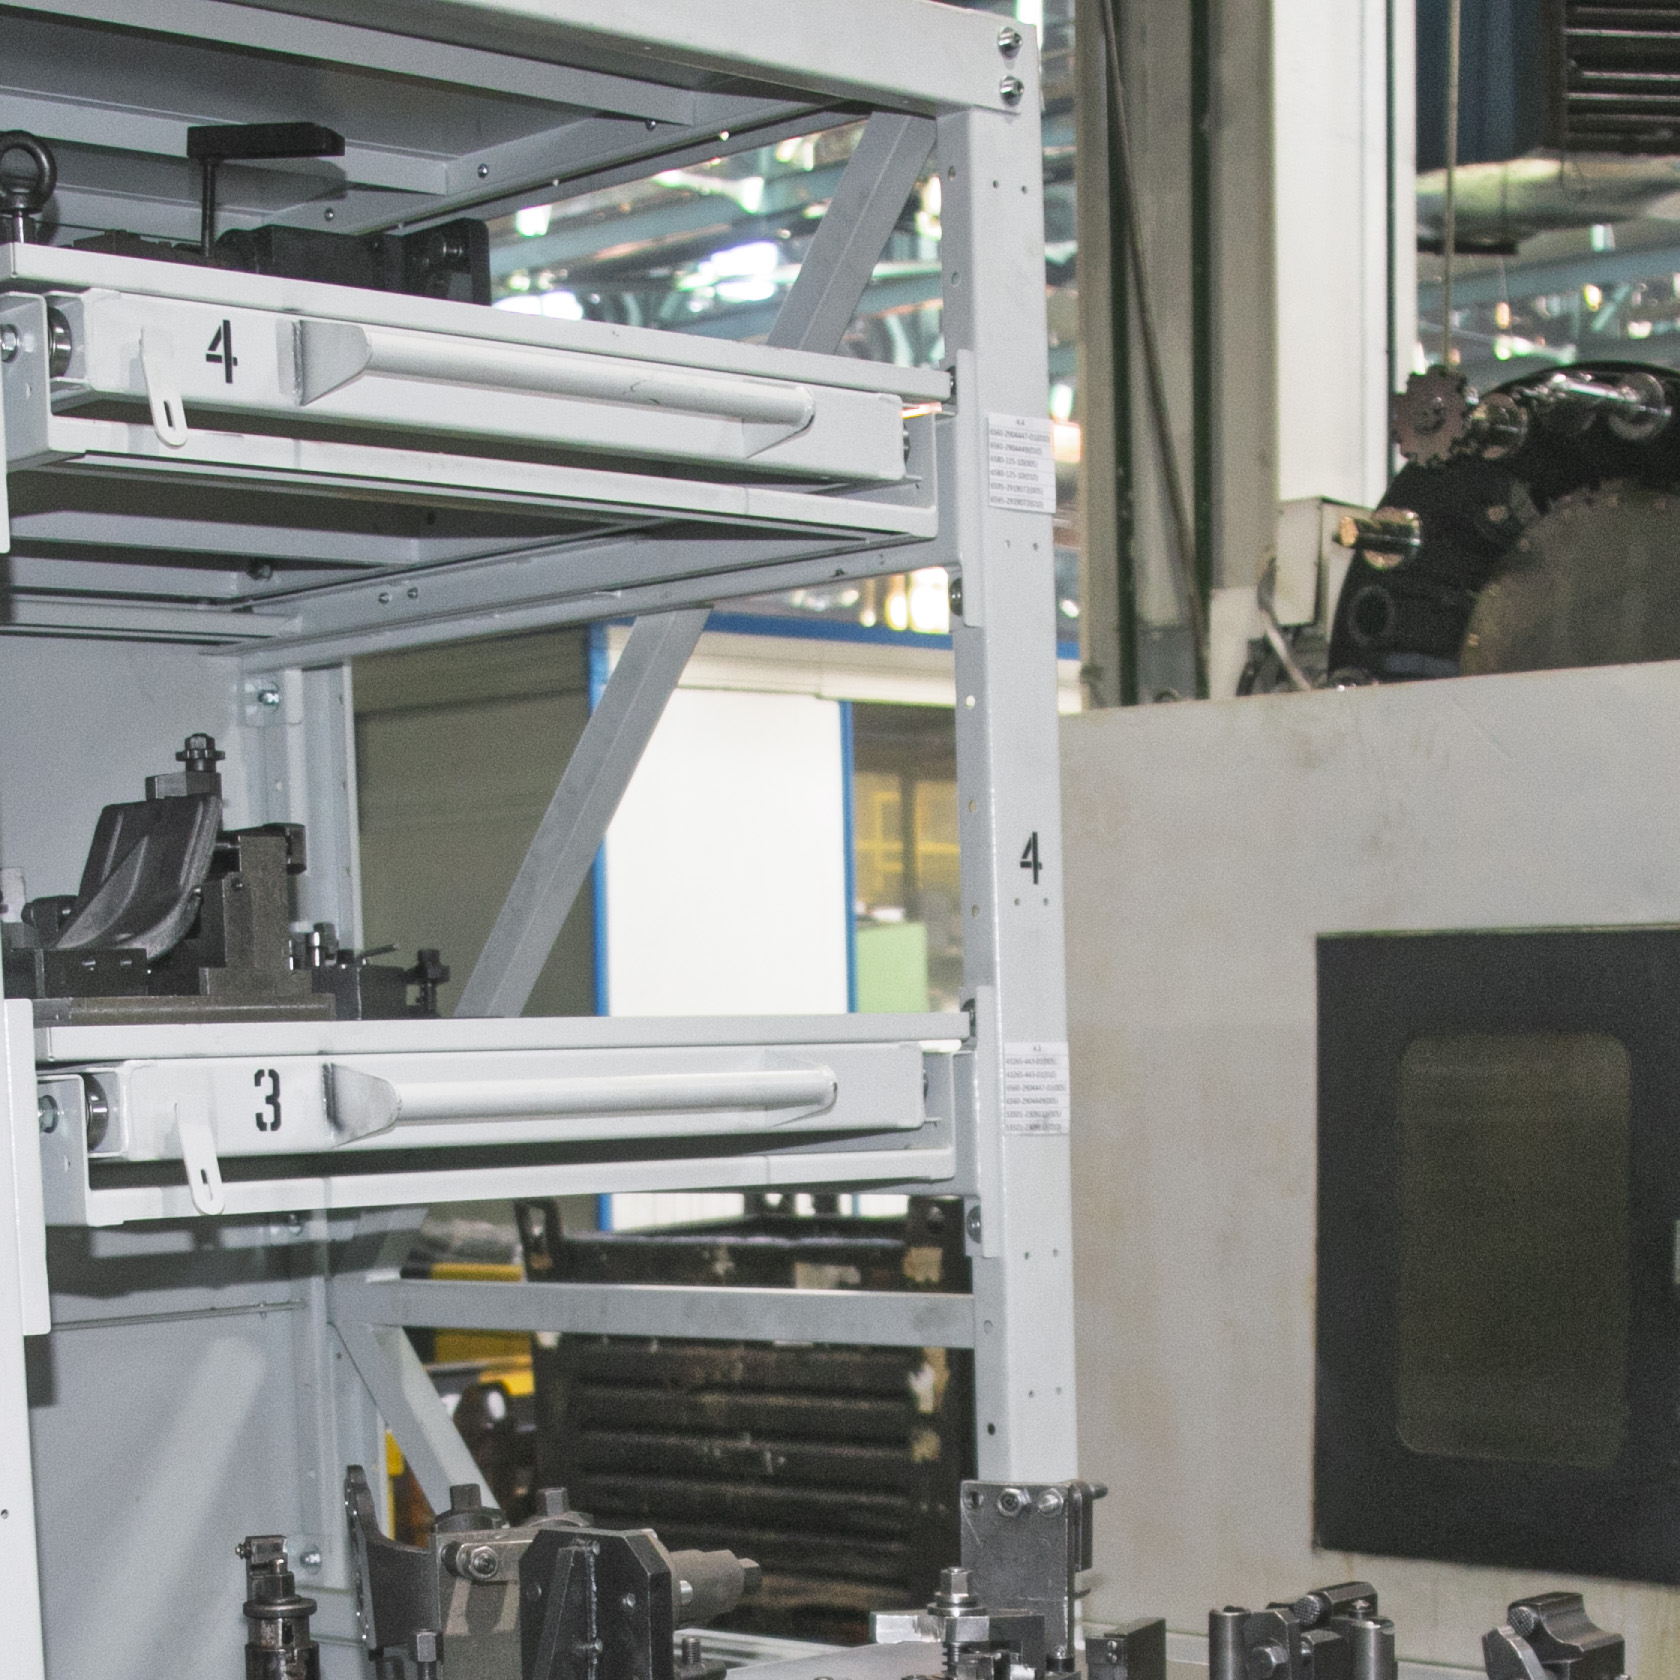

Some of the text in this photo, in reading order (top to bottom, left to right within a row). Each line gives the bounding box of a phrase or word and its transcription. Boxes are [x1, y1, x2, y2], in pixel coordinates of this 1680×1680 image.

[206, 320, 238, 384] 4
[1019, 831, 1043, 885] 4
[254, 1068, 282, 1132] 3
